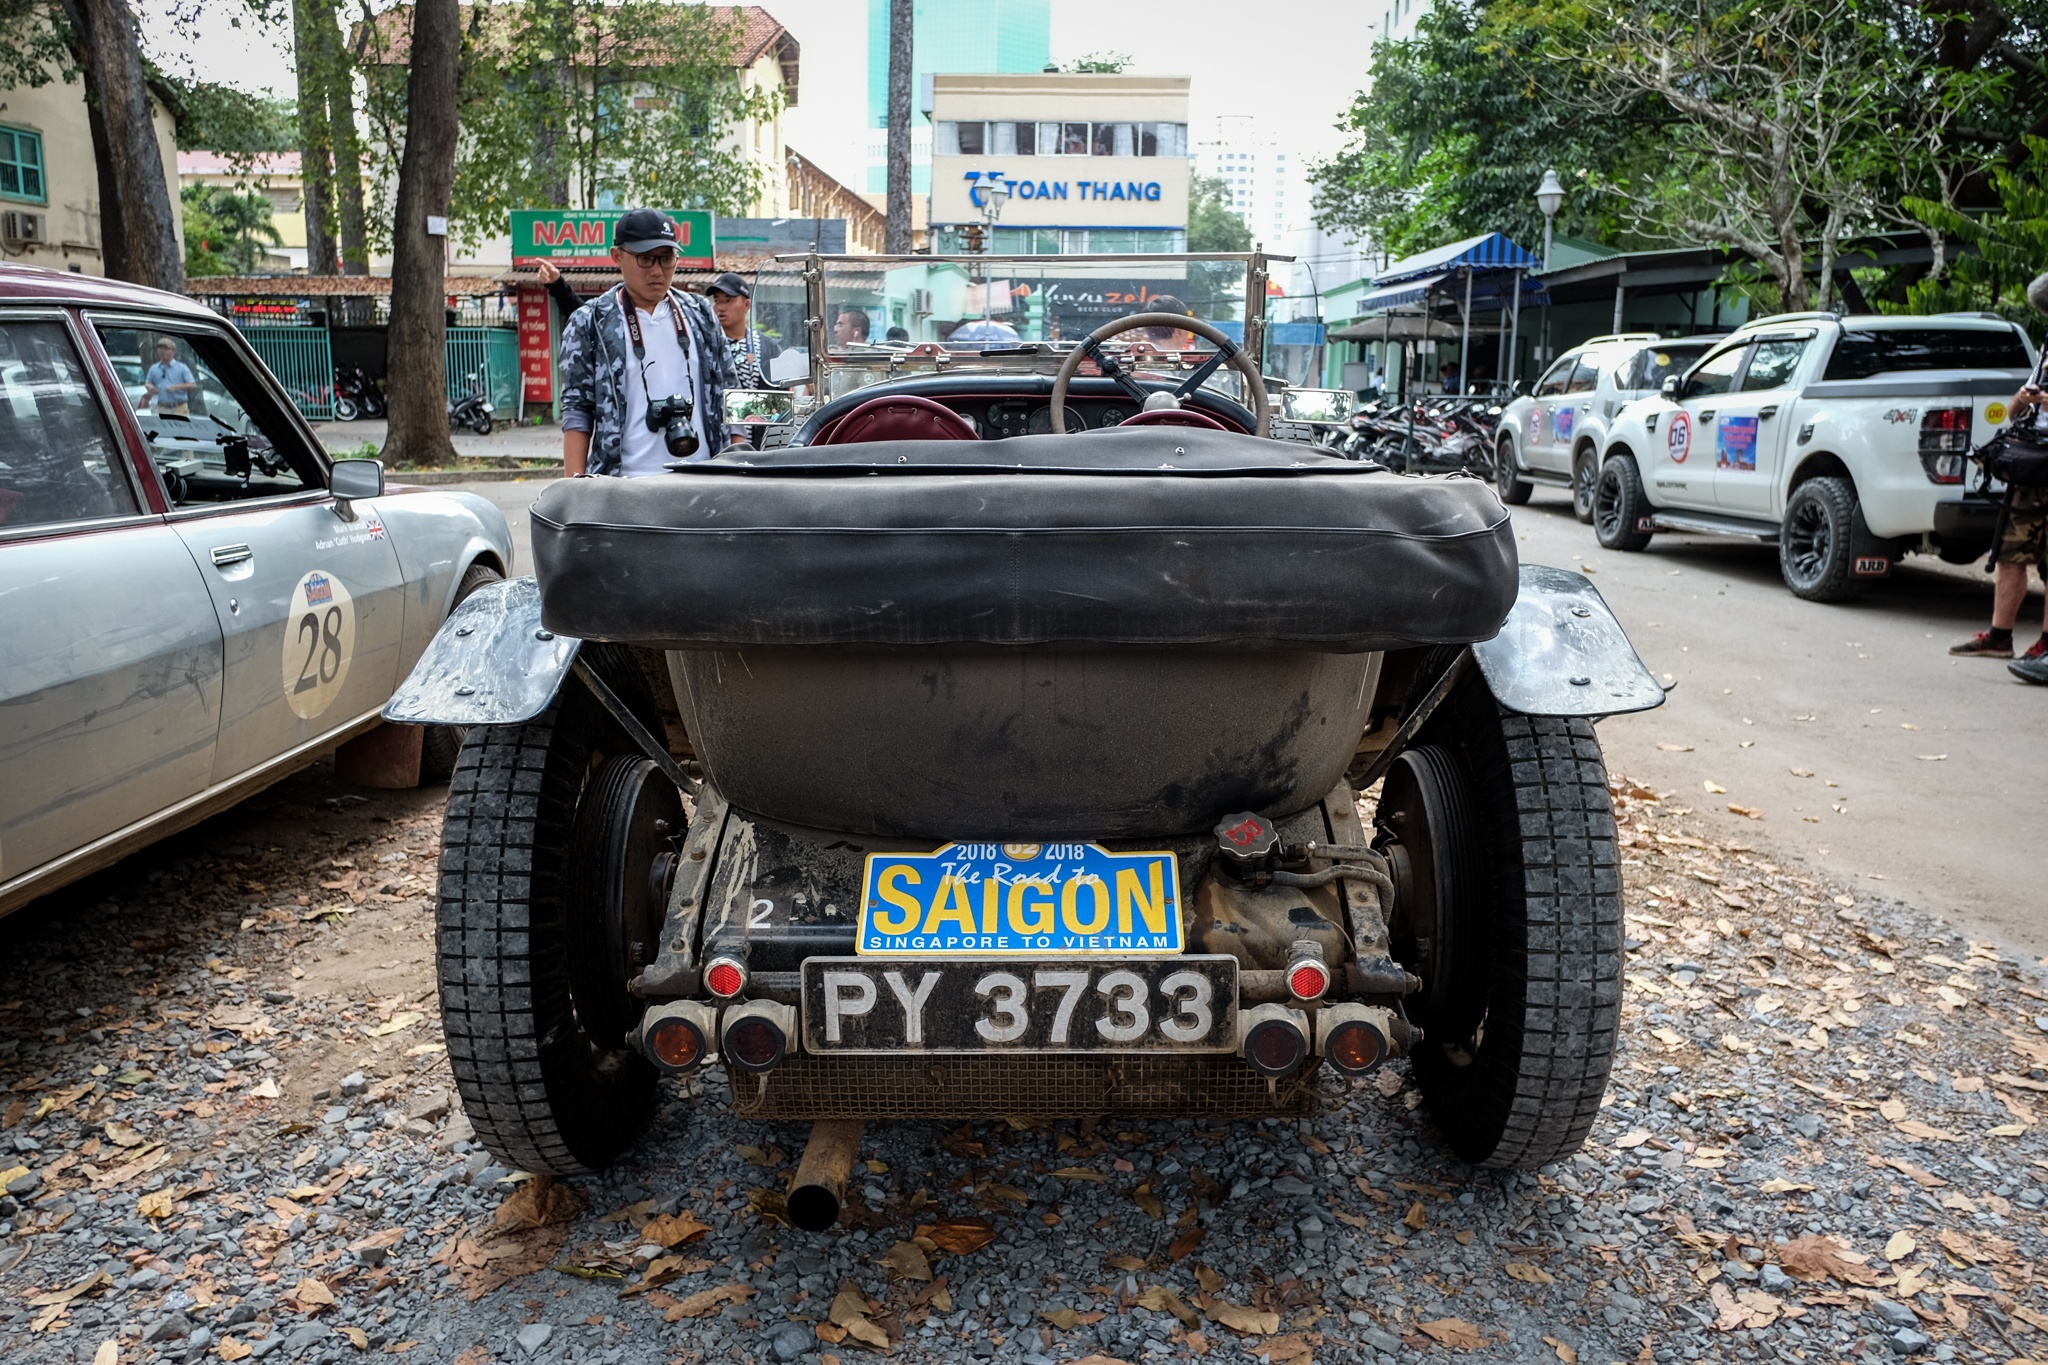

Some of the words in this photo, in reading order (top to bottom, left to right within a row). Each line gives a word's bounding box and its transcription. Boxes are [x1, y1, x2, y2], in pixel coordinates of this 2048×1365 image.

[1004, 180, 1068, 200] TOAN
[1077, 181, 1161, 201] THANG
[533, 220, 605, 246] NAM
[1858, 560, 1886, 572] ARB
[293, 605, 342, 695] 28
[956, 843, 997, 860] 2018
[1045, 843, 1085, 860] 2018
[940, 862, 981, 886] The
[992, 861, 1062, 886] Road
[1071, 865, 1102, 886] to
[873, 860, 1167, 935] SAIGON
[870, 936, 1009, 949] SINGAPORE
[1021, 936, 1050, 949] TO
[1063, 935, 1168, 949] VIETNAM
[823, 971, 942, 1043] PY
[974, 971, 1213, 1043] 3733
